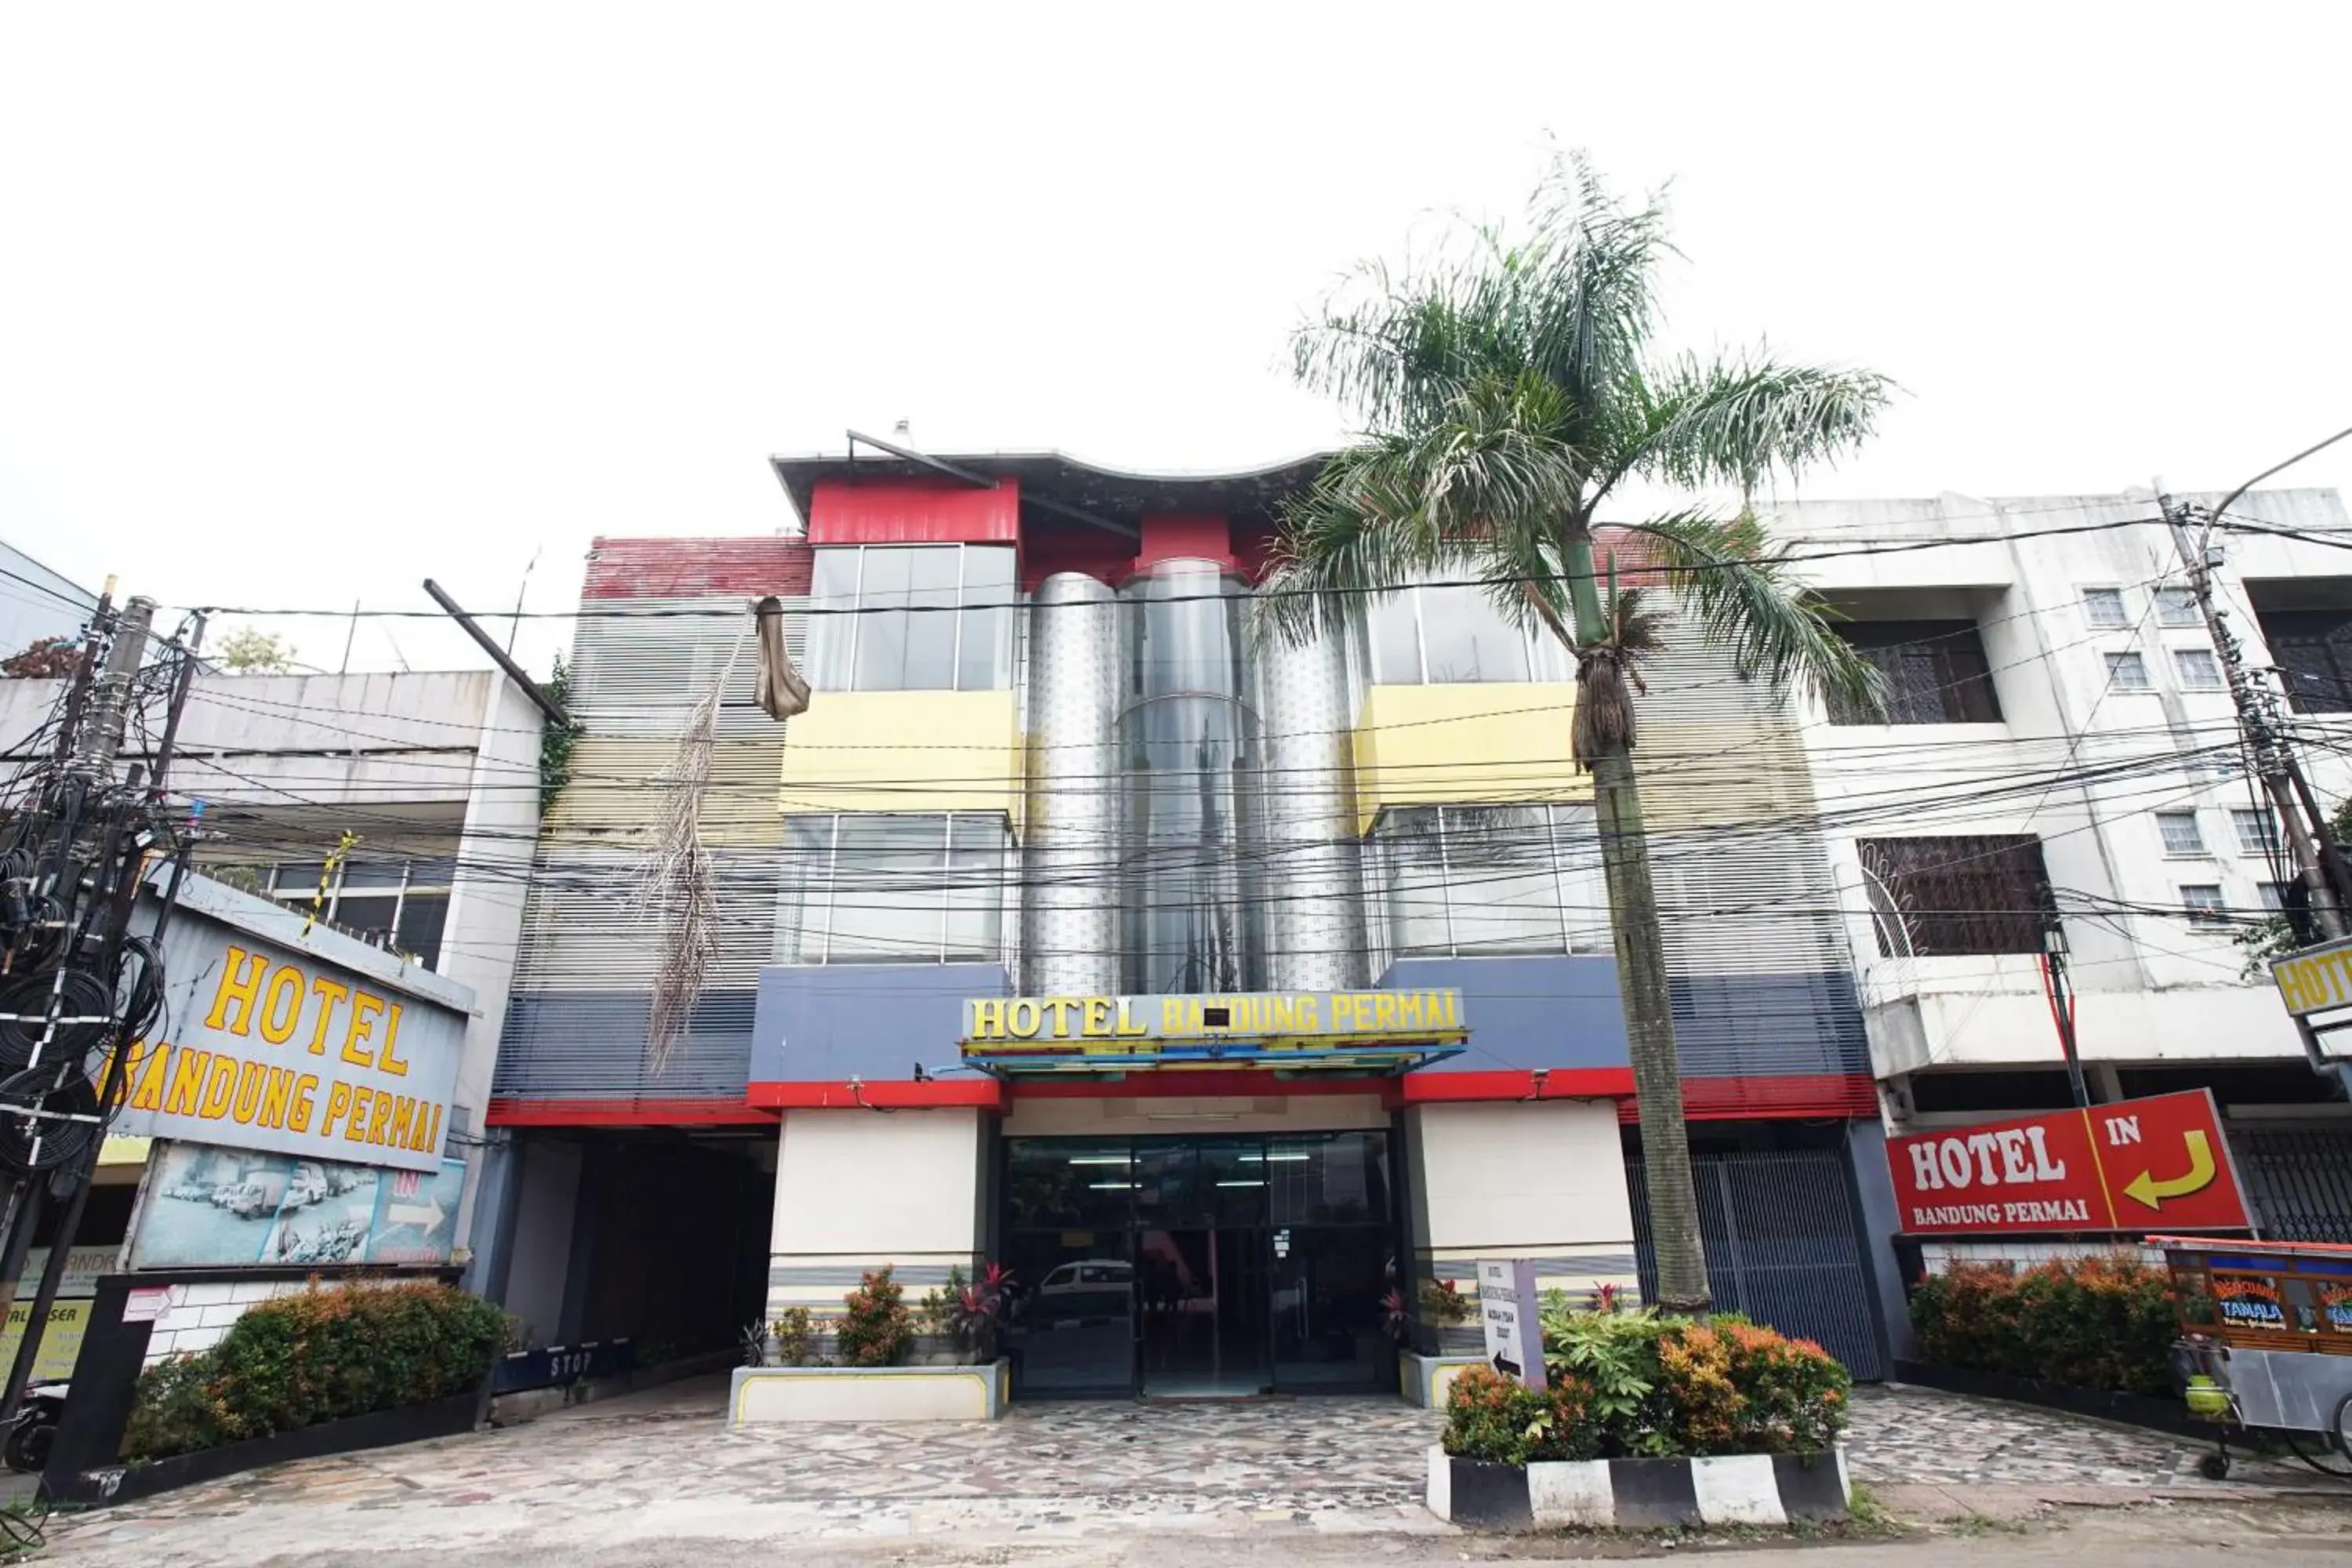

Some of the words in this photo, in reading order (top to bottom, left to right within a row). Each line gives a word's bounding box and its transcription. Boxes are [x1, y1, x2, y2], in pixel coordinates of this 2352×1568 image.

[204, 945, 408, 1076] HOTEL
[972, 996, 1146, 1040] HOTEL
[1332, 990, 1456, 1030] PERMAI
[321, 1080, 443, 1152] PERMAI
[2105, 1116, 2141, 1145] IN
[1908, 1126, 2066, 1191] HOTEL
[1913, 1203, 2001, 1226] BANDUNG
[2004, 1200, 2090, 1224] PERMAI
[2220, 1301, 2284, 1319] TAMALA
[551, 1352, 592, 1376] STOP
